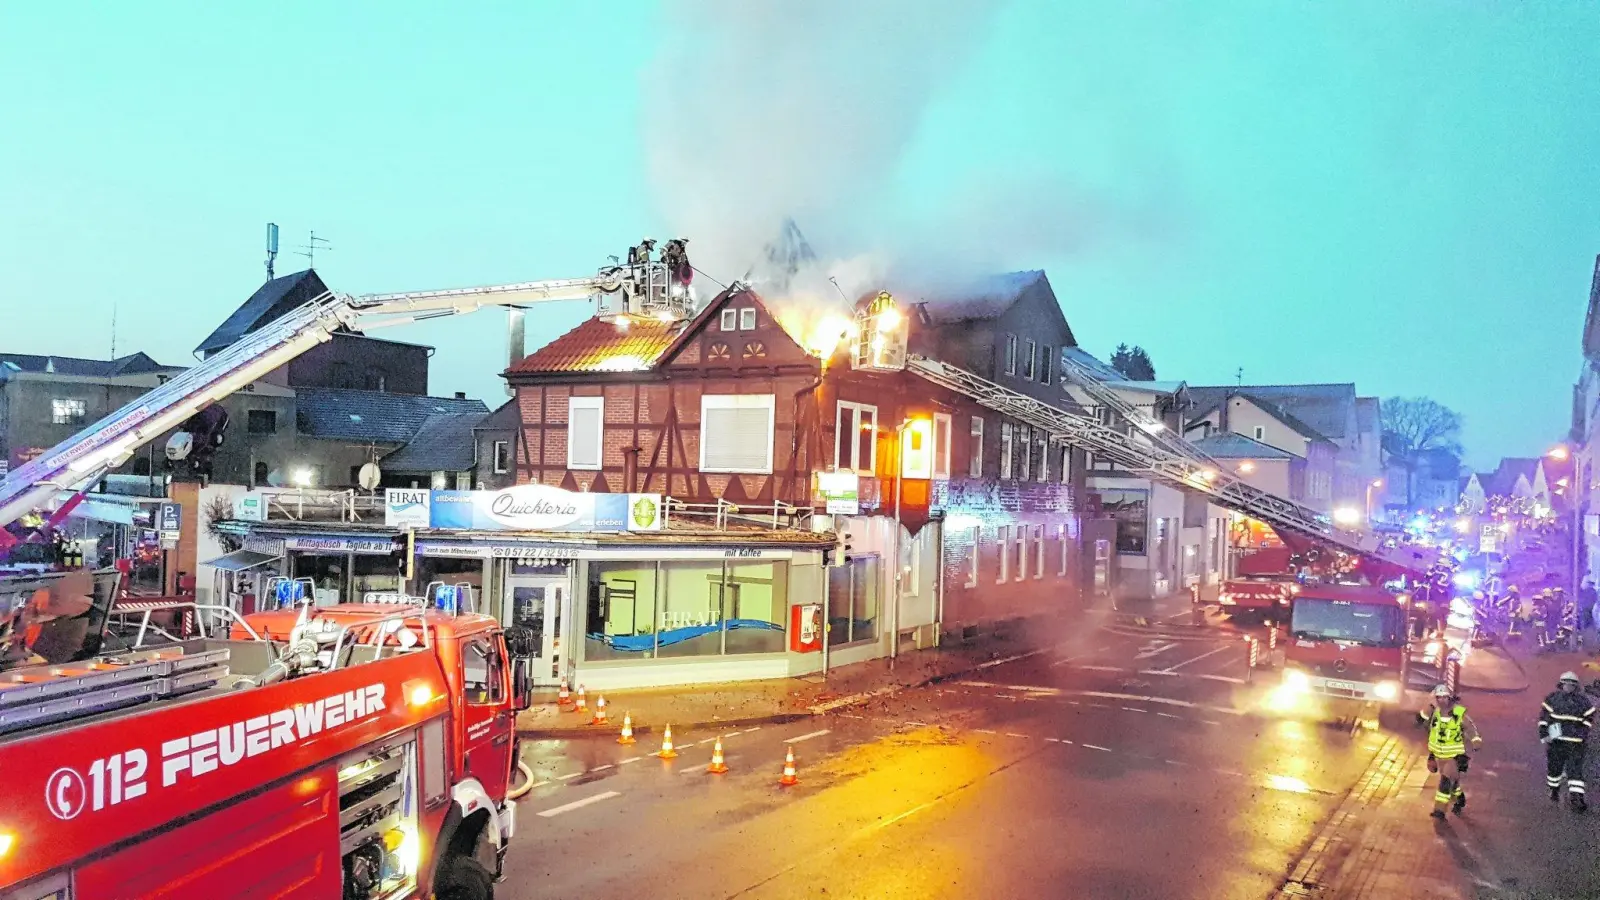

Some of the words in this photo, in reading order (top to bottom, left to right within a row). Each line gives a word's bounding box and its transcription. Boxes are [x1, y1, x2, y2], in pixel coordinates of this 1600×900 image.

[53, 438, 94, 464] FEUERWEHR
[101, 409, 145, 437] STADTHAGEN
[389, 492, 426, 504] FIRAT
[164, 505, 174, 518] P
[492, 493, 577, 518] Quickteria
[596, 518, 624, 526] erleben
[373, 542, 383, 551] ab
[504, 548, 511, 557] 0
[512, 548, 523, 556] 57
[524, 548, 536, 557] 22
[544, 549, 555, 557] 32
[557, 549, 568, 557] 93
[738, 548, 762, 558] Kaffee
[659, 610, 720, 630] FIRAT
[88, 748, 148, 812] 112
[162, 682, 386, 788] FEUERWEHR
